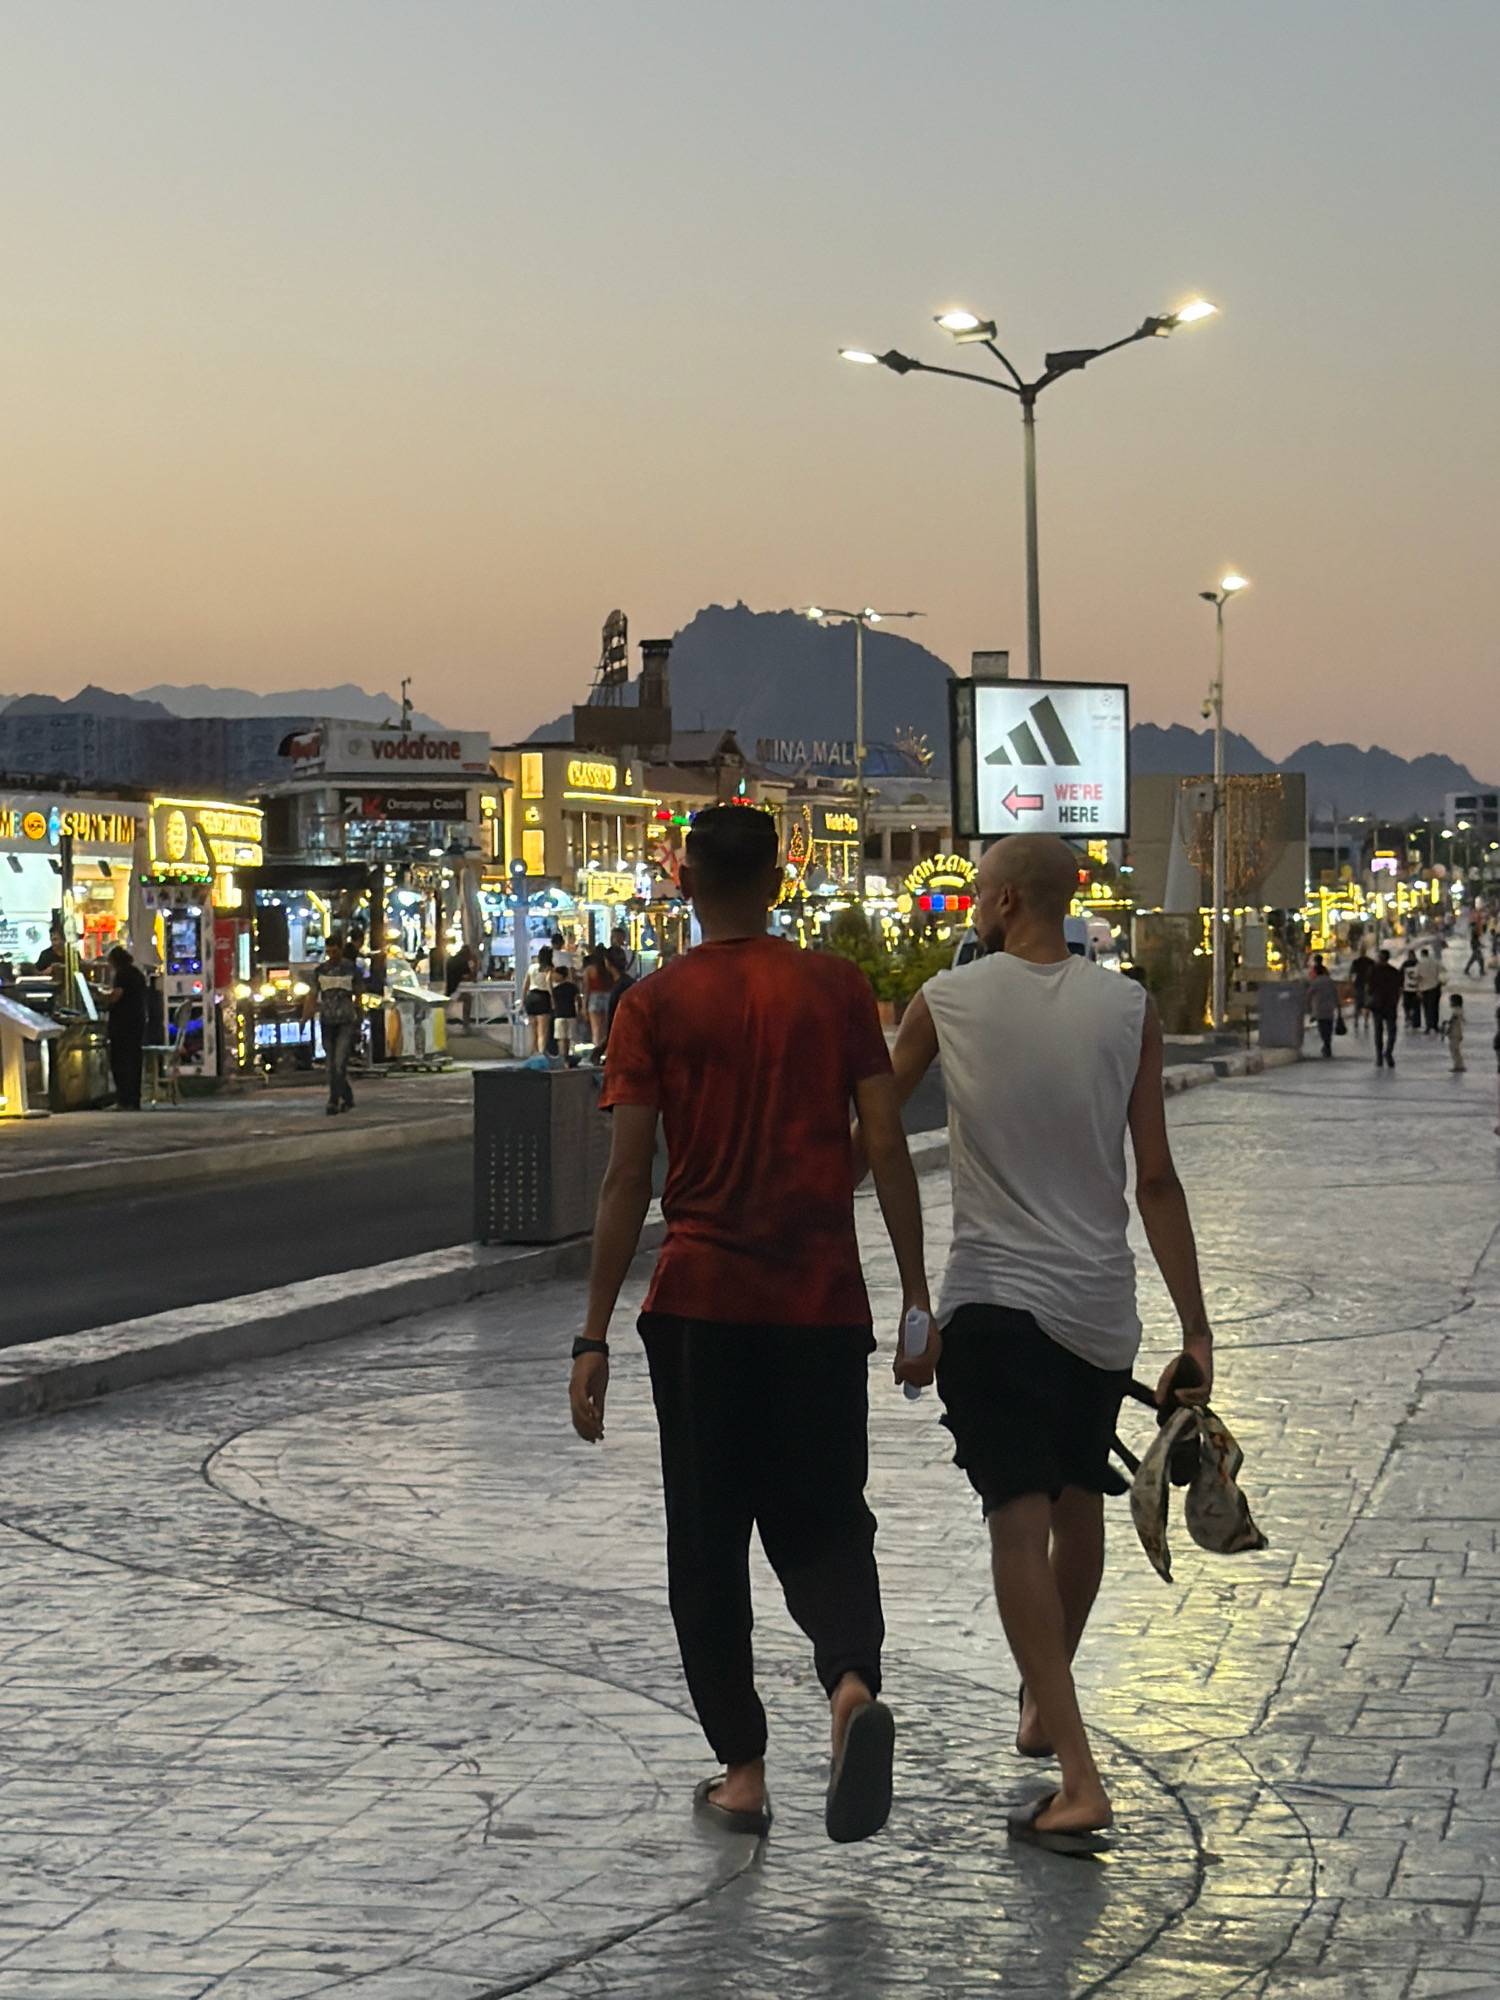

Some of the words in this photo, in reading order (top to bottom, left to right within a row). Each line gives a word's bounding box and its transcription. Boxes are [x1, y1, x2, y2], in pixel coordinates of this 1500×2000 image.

[371, 734, 461, 760] vodafone
[1055, 784, 1103, 801] WE'RE
[387, 798, 431, 812] Orange
[433, 798, 463, 810] Cash
[1058, 806, 1099, 823] HERE
